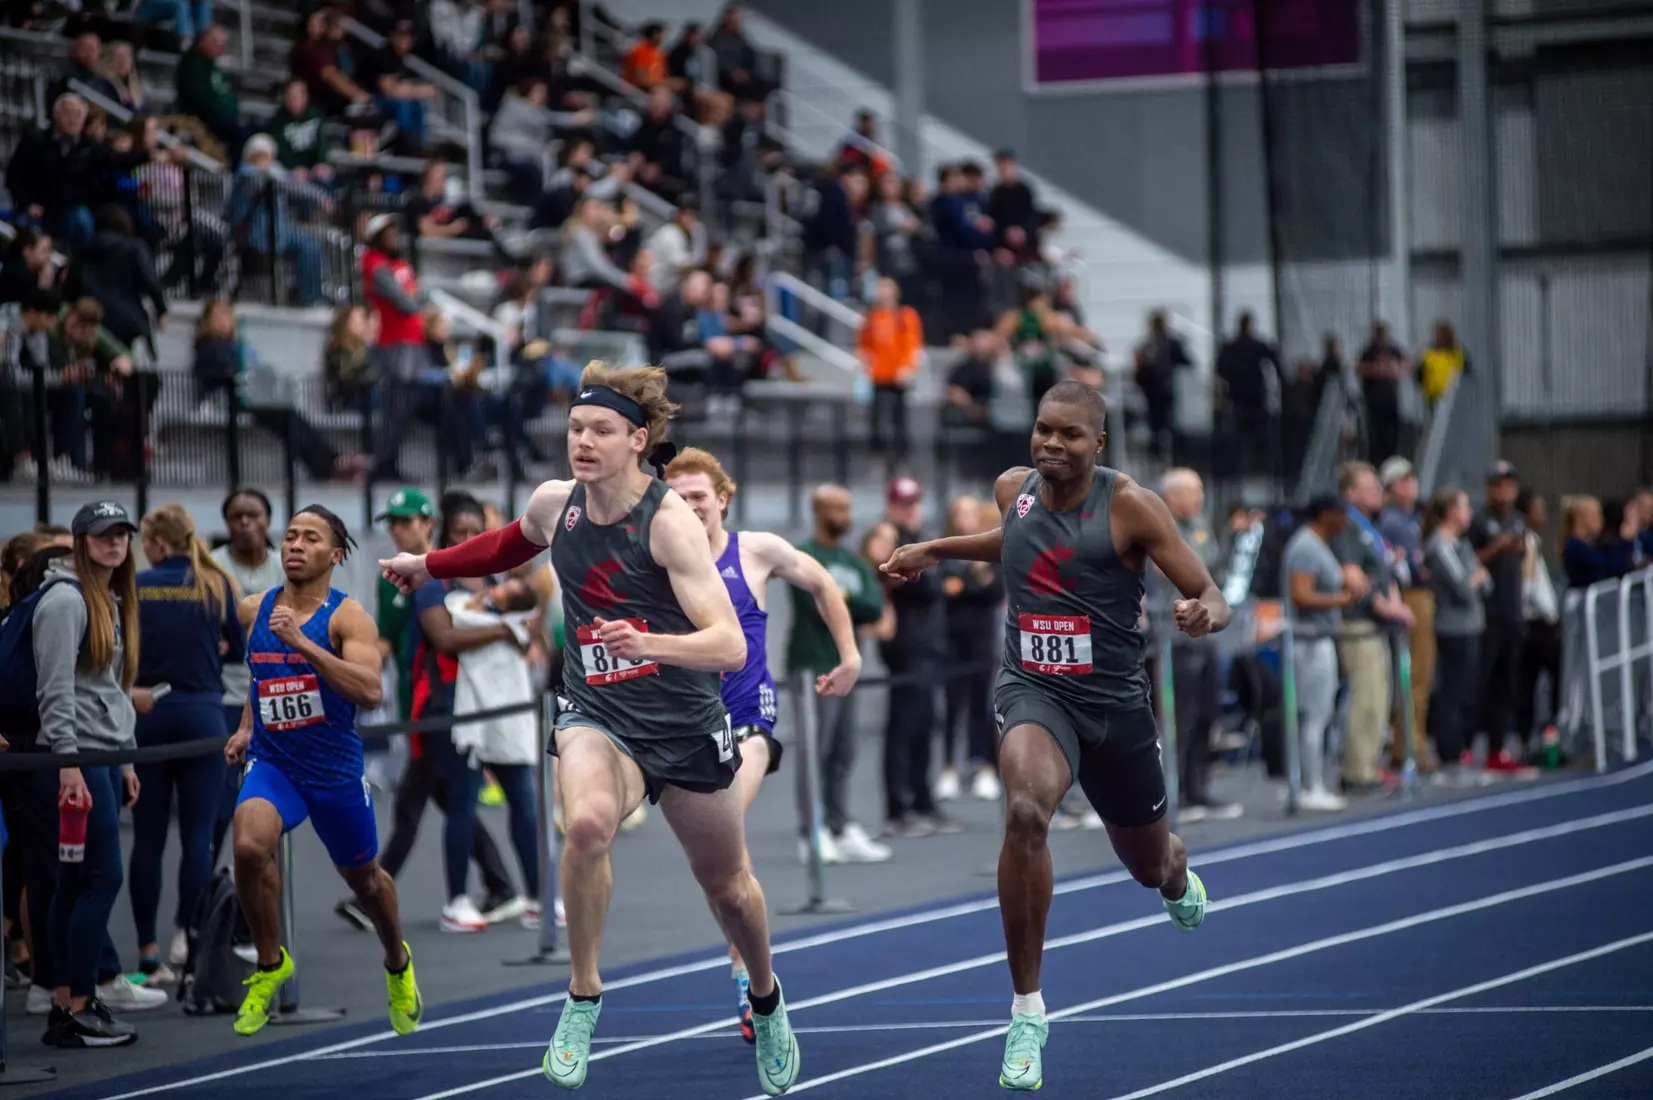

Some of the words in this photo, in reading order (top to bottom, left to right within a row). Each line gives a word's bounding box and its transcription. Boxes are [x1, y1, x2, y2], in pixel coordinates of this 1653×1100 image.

[1032, 619, 1051, 630] WSU
[1053, 620, 1074, 631] OPEN
[1031, 634, 1079, 664] 881
[269, 682, 285, 693] WSU
[286, 680, 305, 692] OPEN
[268, 694, 312, 722] 166
